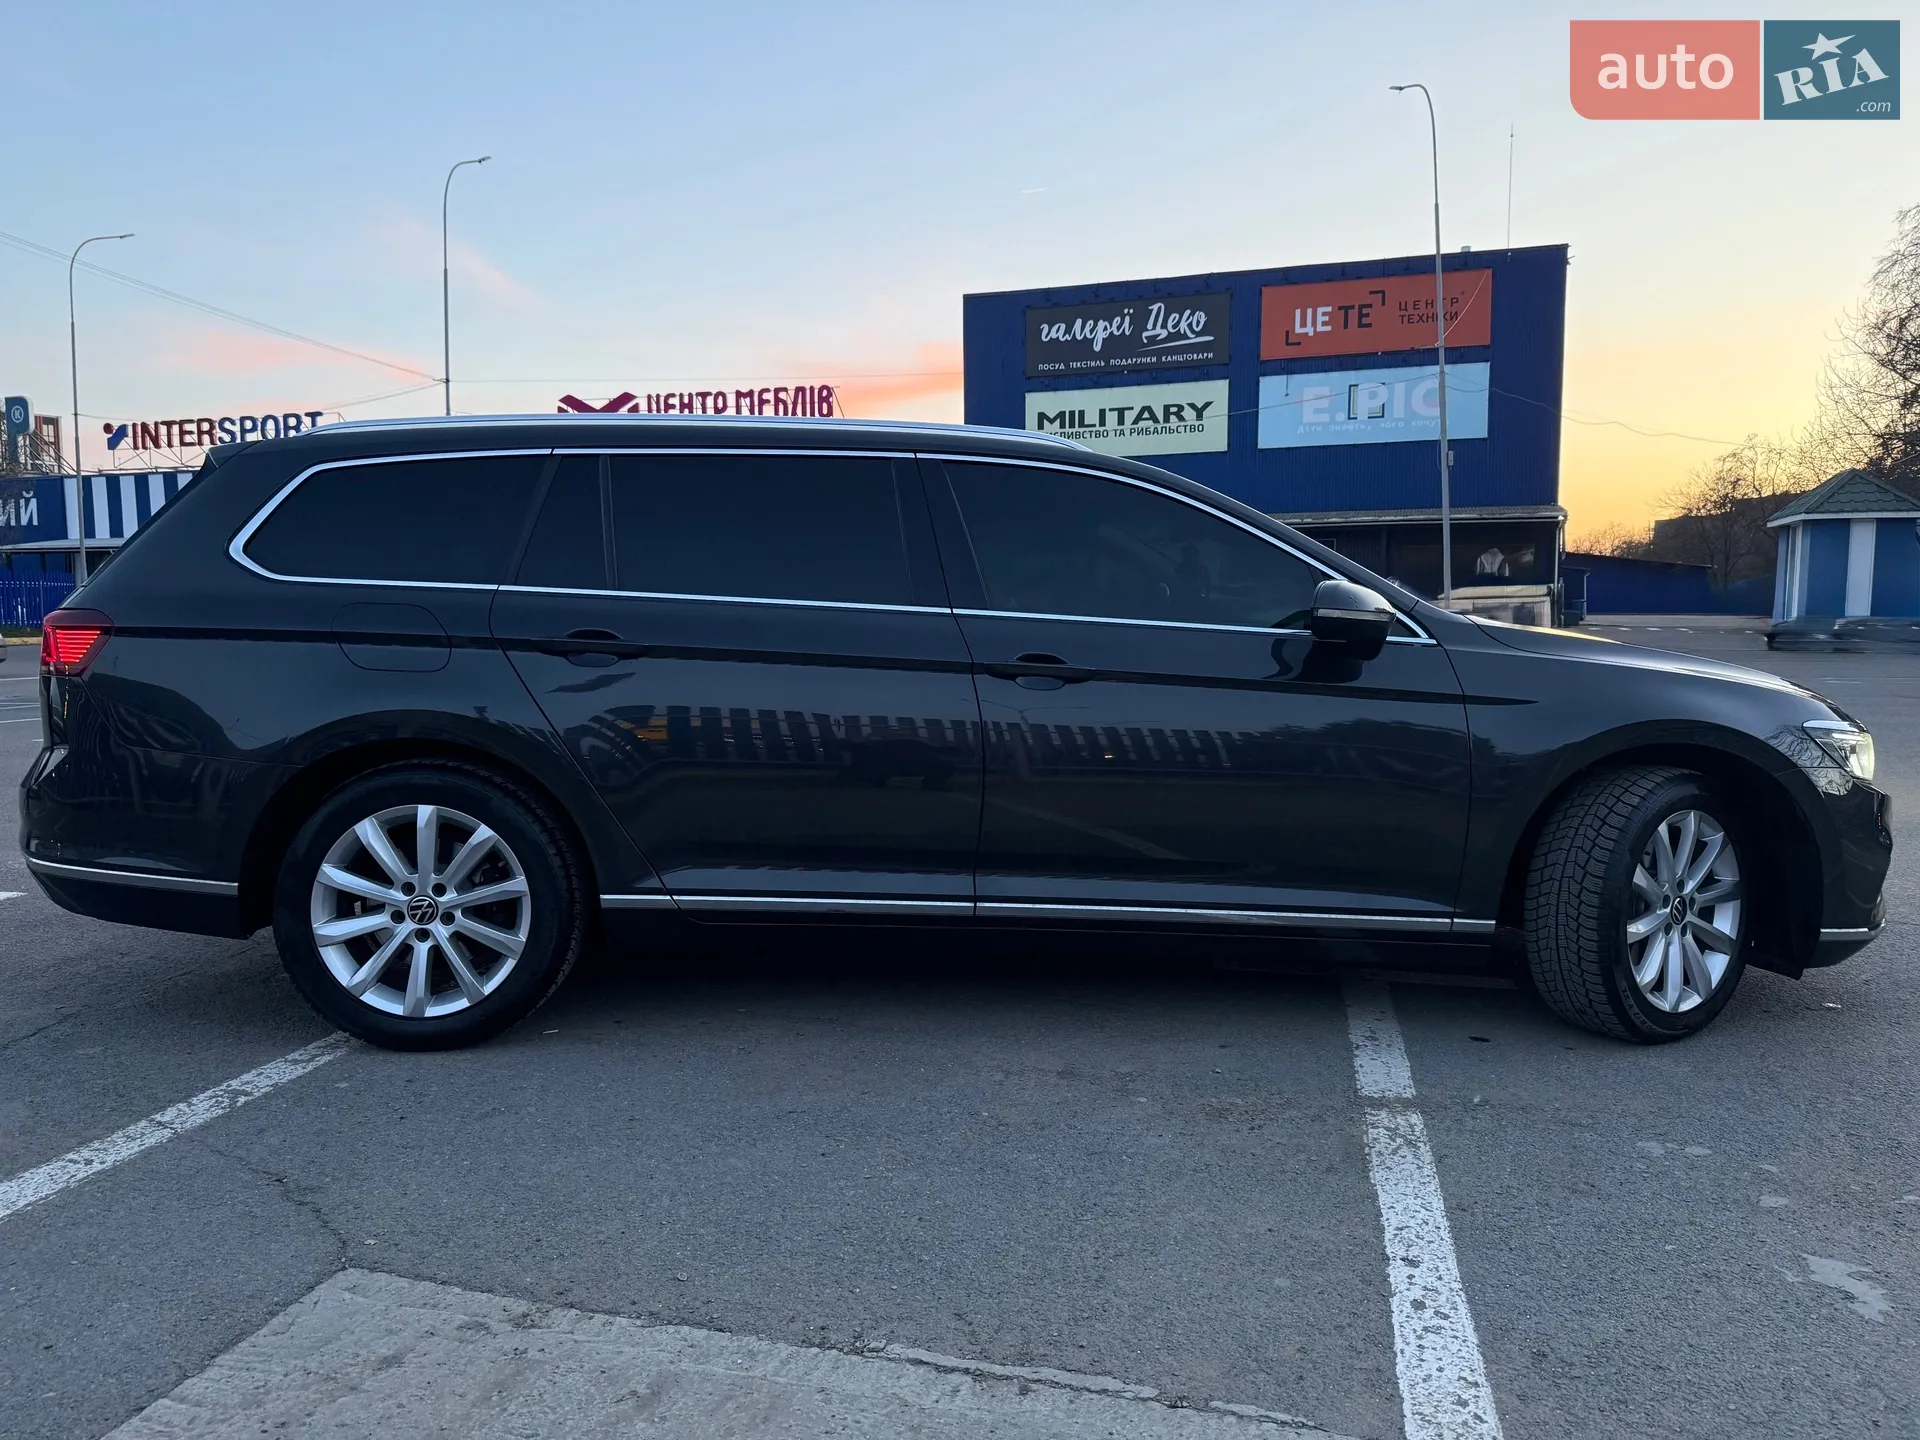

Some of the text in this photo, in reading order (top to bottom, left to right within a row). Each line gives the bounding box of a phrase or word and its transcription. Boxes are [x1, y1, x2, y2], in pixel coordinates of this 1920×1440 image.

[1398, 297, 1459, 312] ЦЕНР
[1039, 302, 1208, 352] галереї Деко
[1038, 352, 1214, 372] ПОСУД ТЕКСТИЛЬ ПОДАРУНКИ КАНЦТОВАРИ
[1302, 378, 1440, 423] E.PIC
[132, 411, 323, 450] INTERSPORT
[1037, 401, 1214, 431] MILITARY
[1113, 428, 1126, 438] ТА
[1129, 423, 1205, 437] РИБАЛЬСТВО
